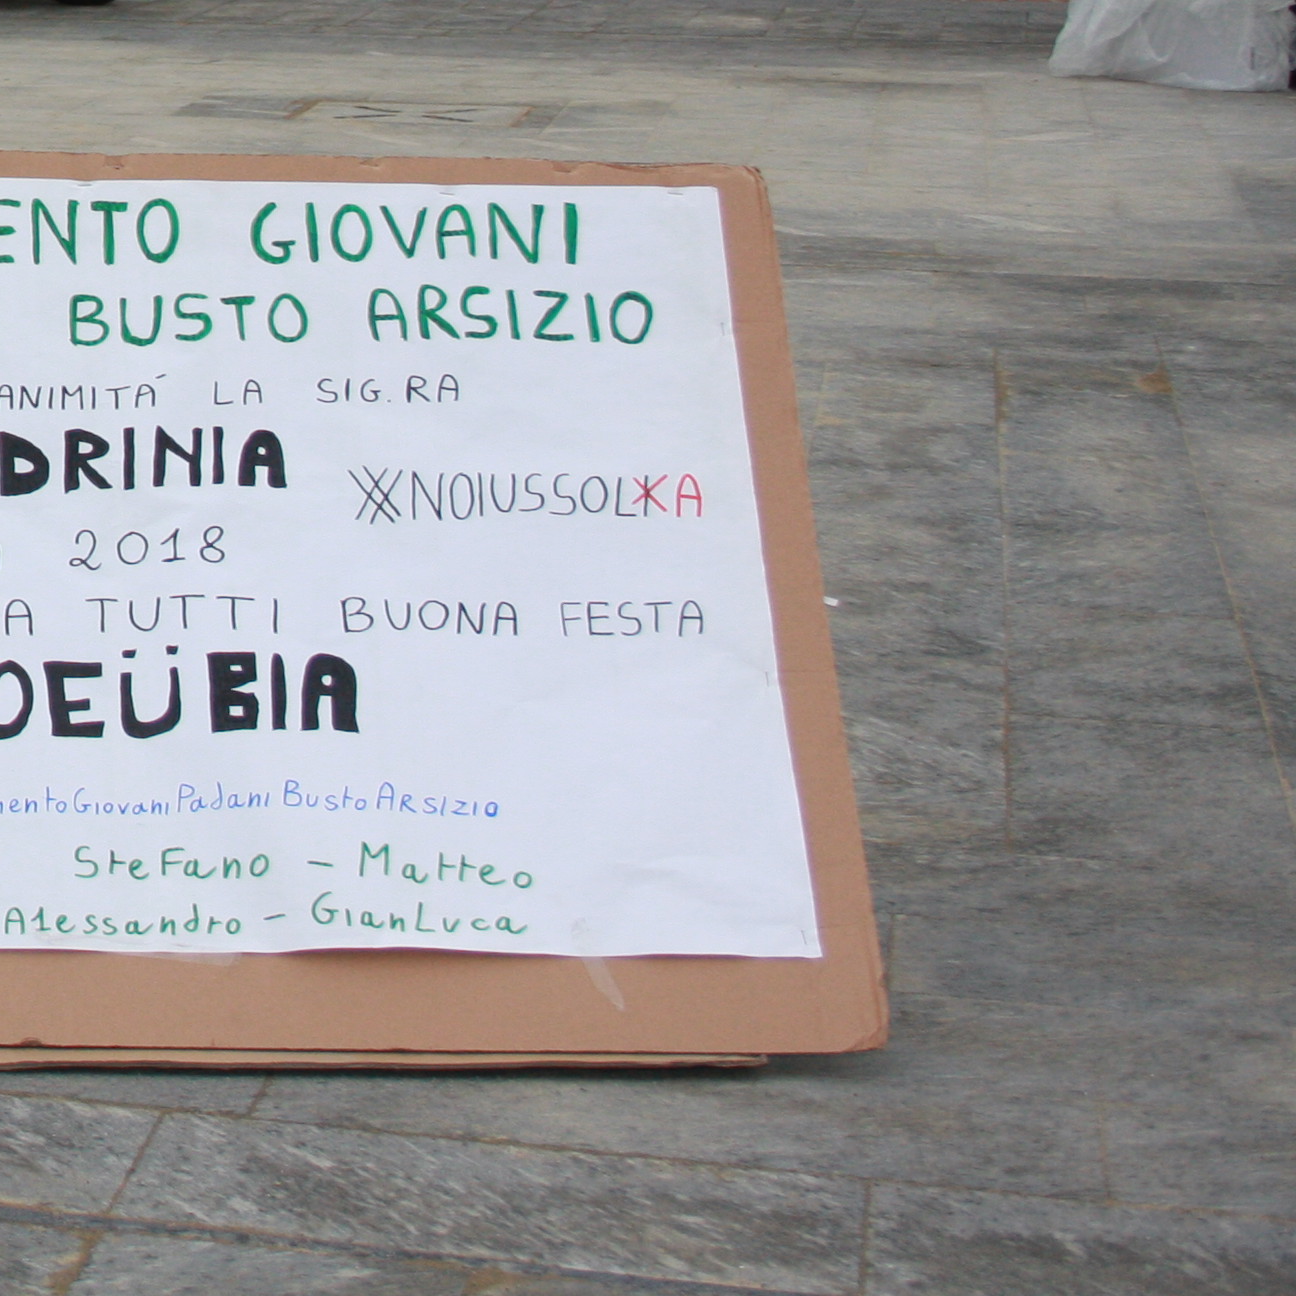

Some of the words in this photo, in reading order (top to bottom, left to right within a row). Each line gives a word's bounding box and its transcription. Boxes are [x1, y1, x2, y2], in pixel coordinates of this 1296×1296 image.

[250, 201, 578, 265] GIOVANI
[70, 292, 308, 346] BUSTO
[368, 284, 653, 344] ARSIZIO
[214, 380, 263, 404] LA
[316, 374, 461, 403] SIG.RA
[69, 525, 226, 570] 2018
[4, 599, 34, 637] A
[86, 595, 279, 636] TUTTI
[340, 596, 518, 636] BUONA
[559, 600, 704, 637] FESTA
[359, 841, 534, 889] Matteo
